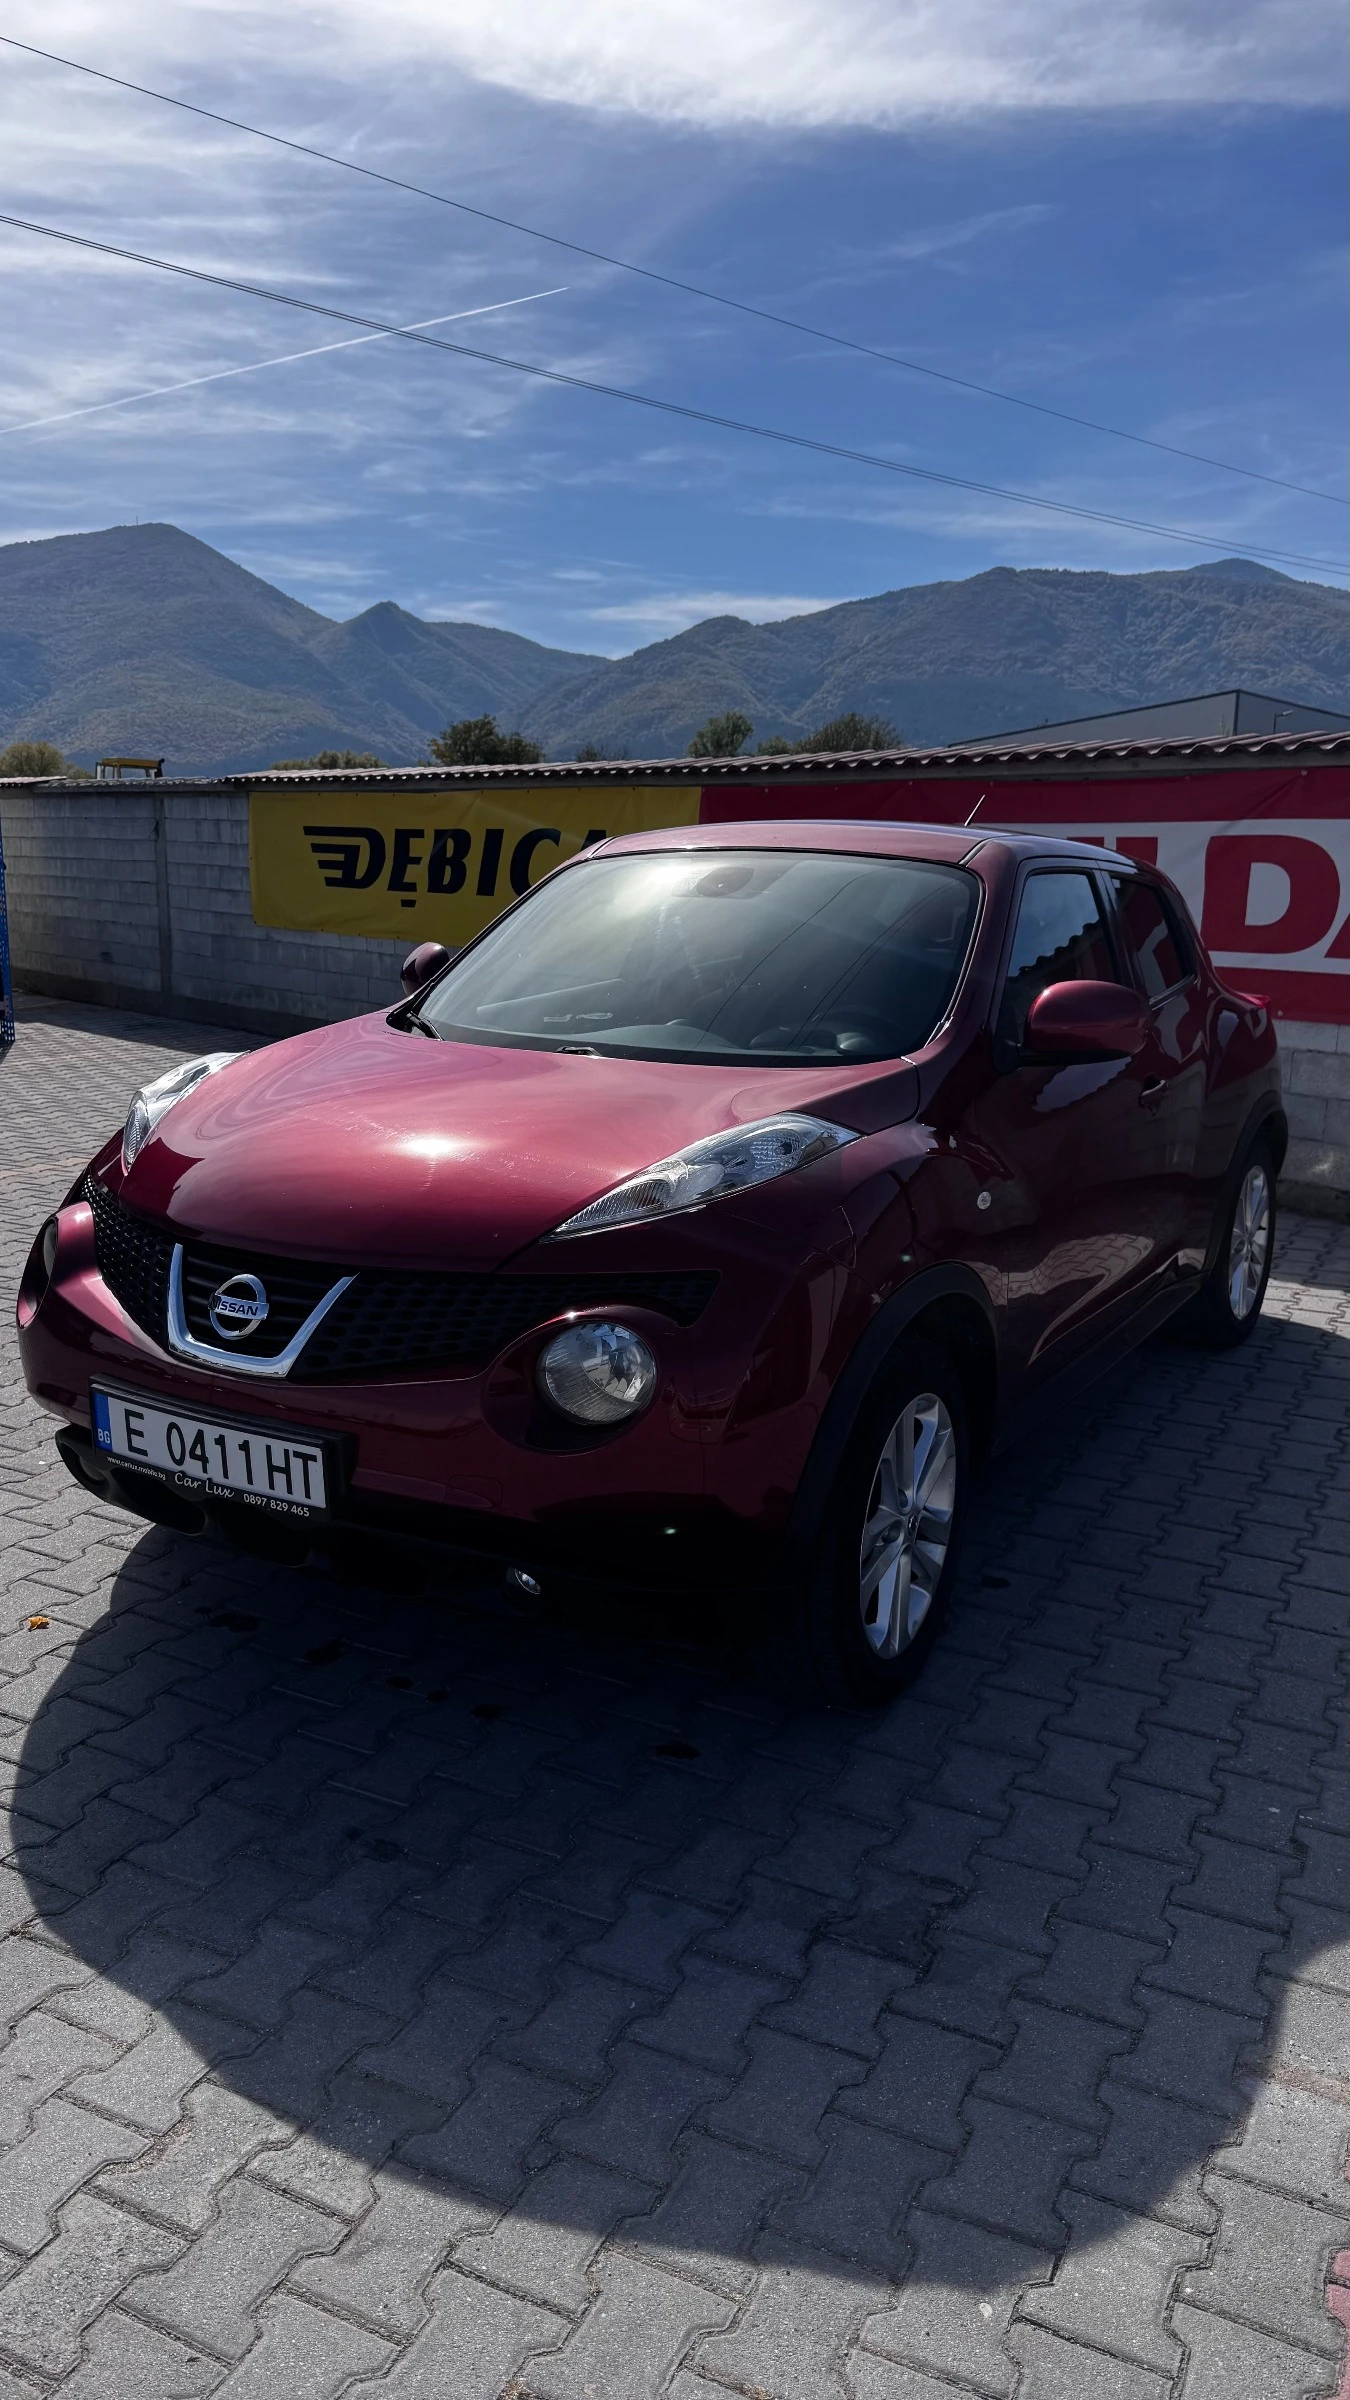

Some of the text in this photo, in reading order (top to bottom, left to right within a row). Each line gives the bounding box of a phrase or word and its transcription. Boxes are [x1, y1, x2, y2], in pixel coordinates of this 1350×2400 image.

[98, 1428, 111, 1444] BG
[174, 1473, 201, 1489] Car
[205, 1480, 235, 1498] Lux
[243, 1493, 268, 1507] 0897
[270, 1499, 289, 1512] 829
[291, 1504, 310, 1517] 465
